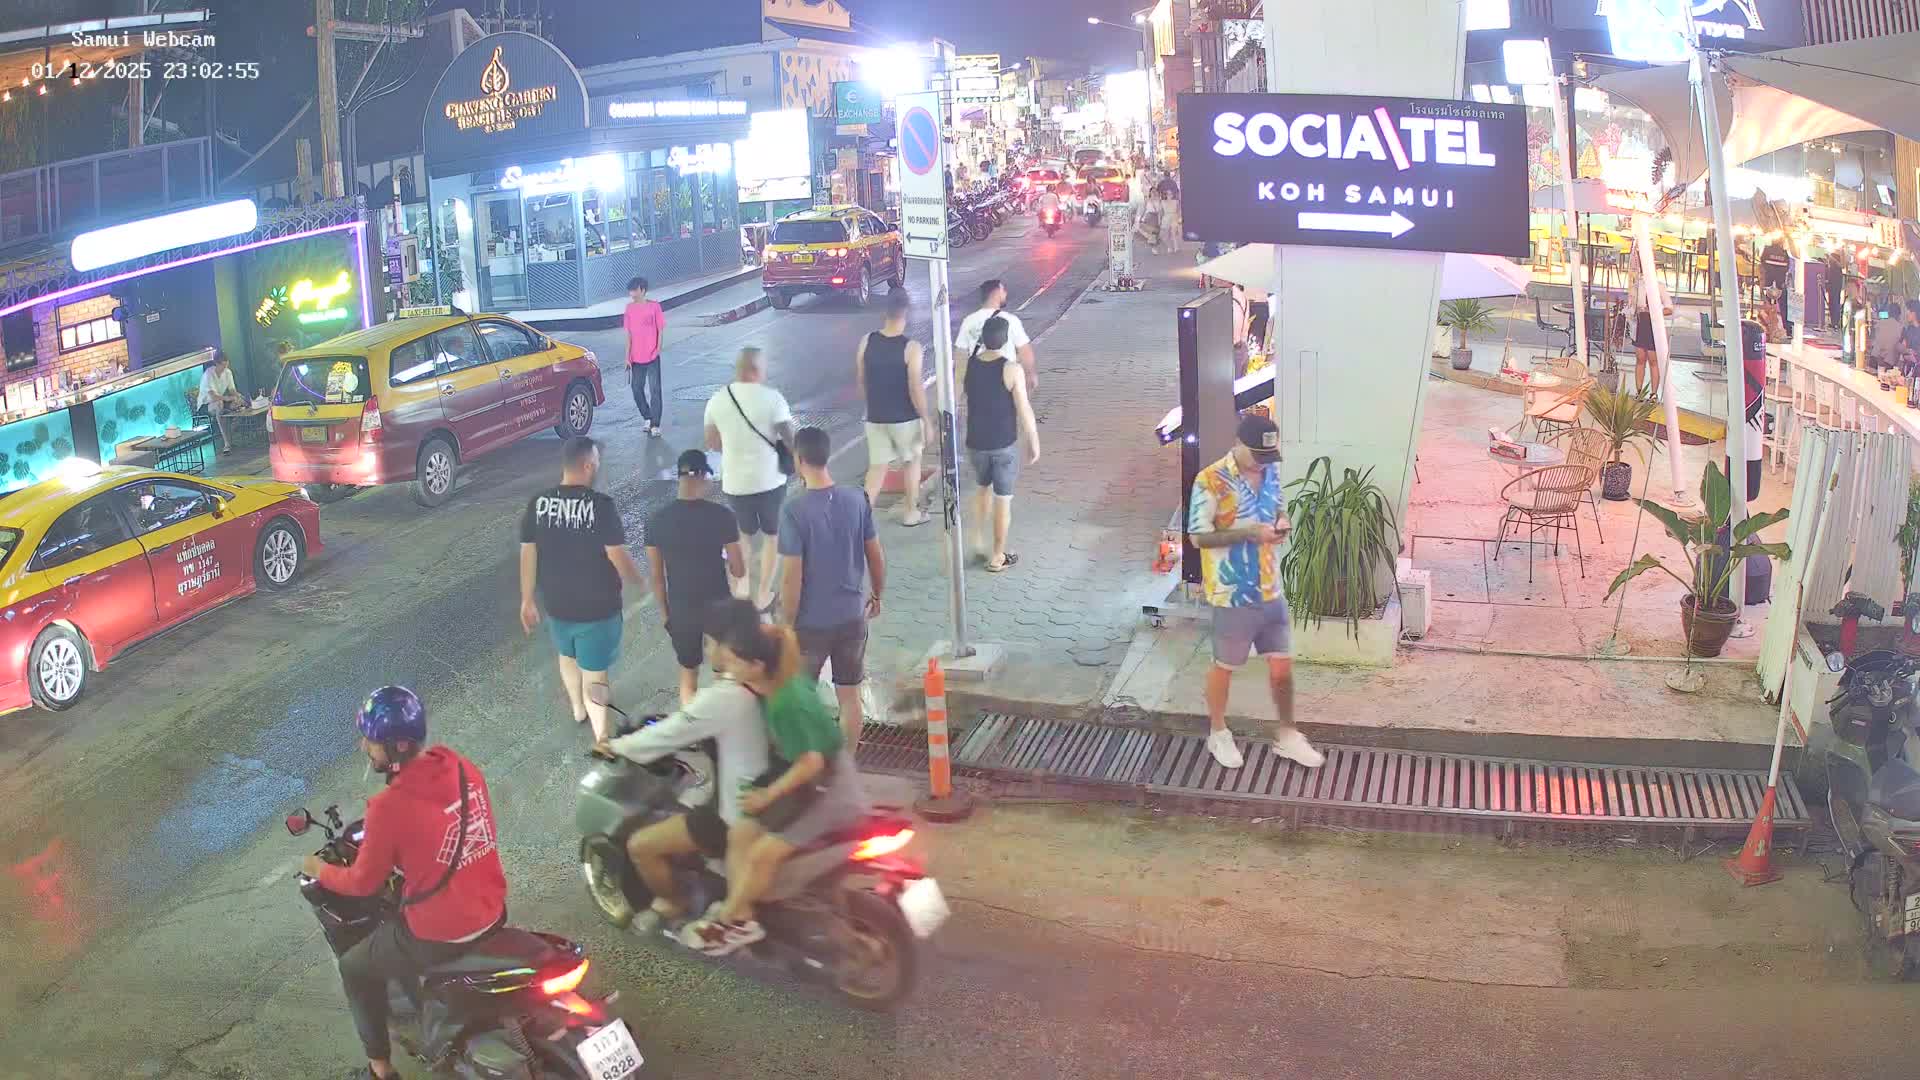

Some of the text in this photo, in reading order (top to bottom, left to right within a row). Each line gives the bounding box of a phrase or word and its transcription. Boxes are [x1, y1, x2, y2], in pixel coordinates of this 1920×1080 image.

[1258, 181, 1455, 208] KOH SAMUI
[907, 215, 940, 225] NO PARKING
[535, 495, 595, 528] DENIM
[602, 1055, 636, 1080] 9328
